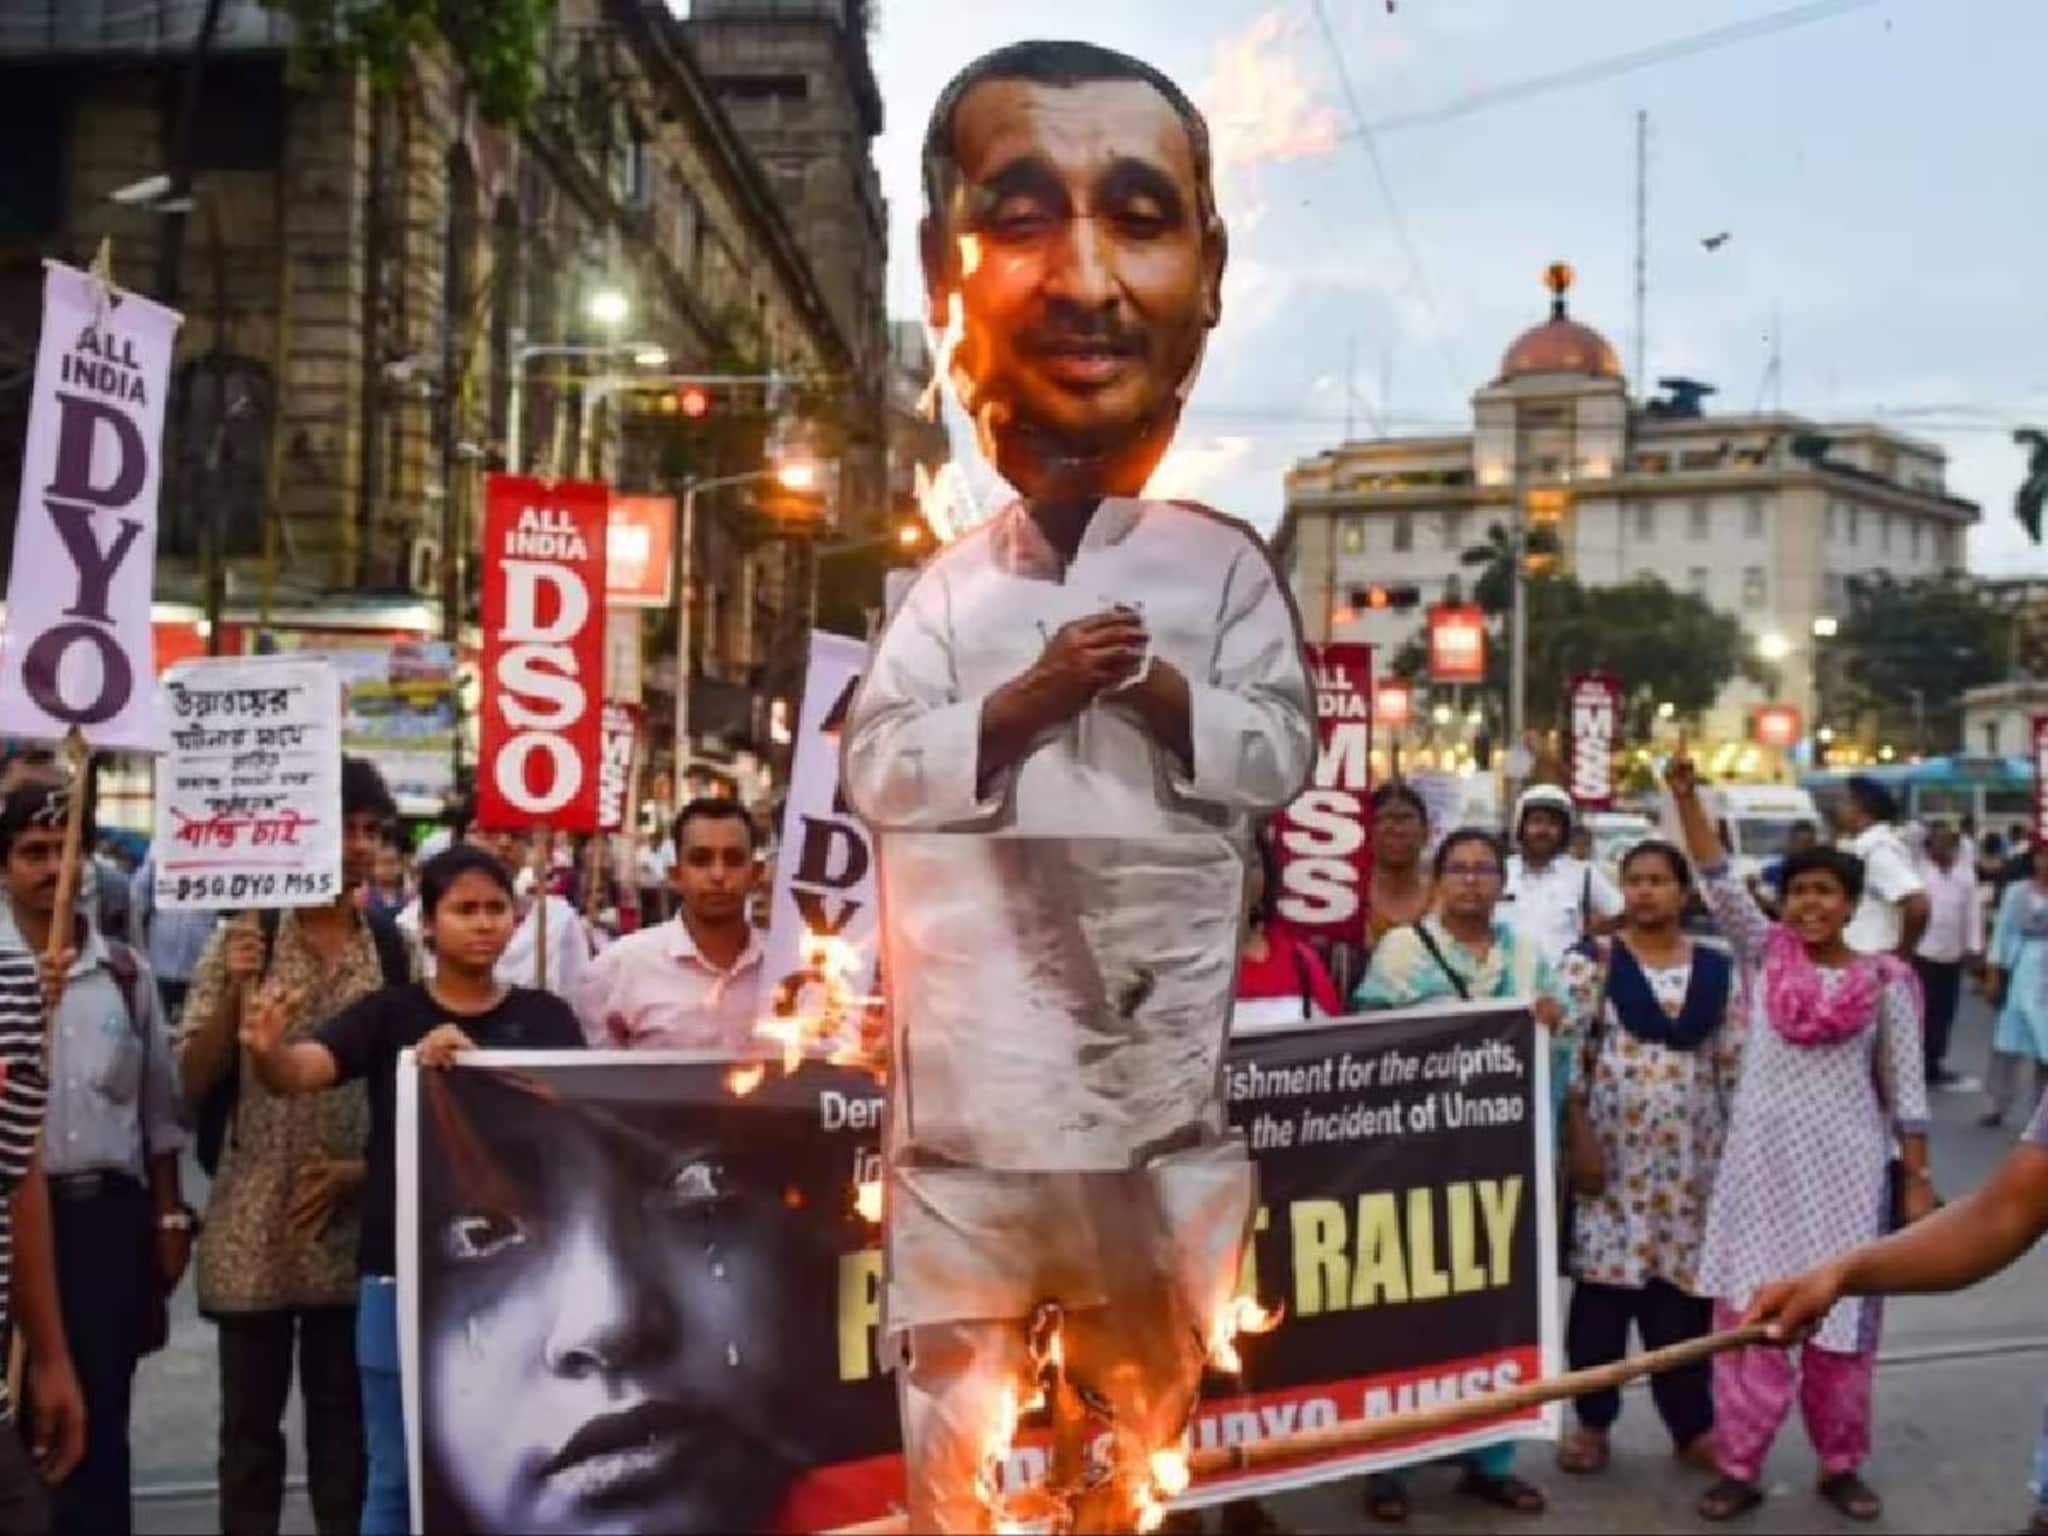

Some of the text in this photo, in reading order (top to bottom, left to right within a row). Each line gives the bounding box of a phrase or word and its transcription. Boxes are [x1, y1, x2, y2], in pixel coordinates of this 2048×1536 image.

[75, 325, 140, 369] ALL
[62, 354, 147, 407] INDIA
[518, 505, 578, 533] ALL
[22, 391, 148, 724] DYO
[504, 530, 588, 561] INDIA
[496, 559, 590, 814] DSO
[1311, 665, 1353, 690] LL
[1317, 693, 1367, 718] DIA
[251, 808, 318, 846] চাই
[1223, 1058, 1332, 1102] ishment
[1338, 1052, 1377, 1092] for
[1379, 1049, 1419, 1085] the
[1422, 1038, 1524, 1089] culprits,
[1252, 1111, 1293, 1149] the
[1301, 1102, 1402, 1143] incident
[1407, 1094, 1438, 1133] of
[1444, 1091, 1525, 1130] Unnao
[1290, 1174, 1524, 1317] RALLY
